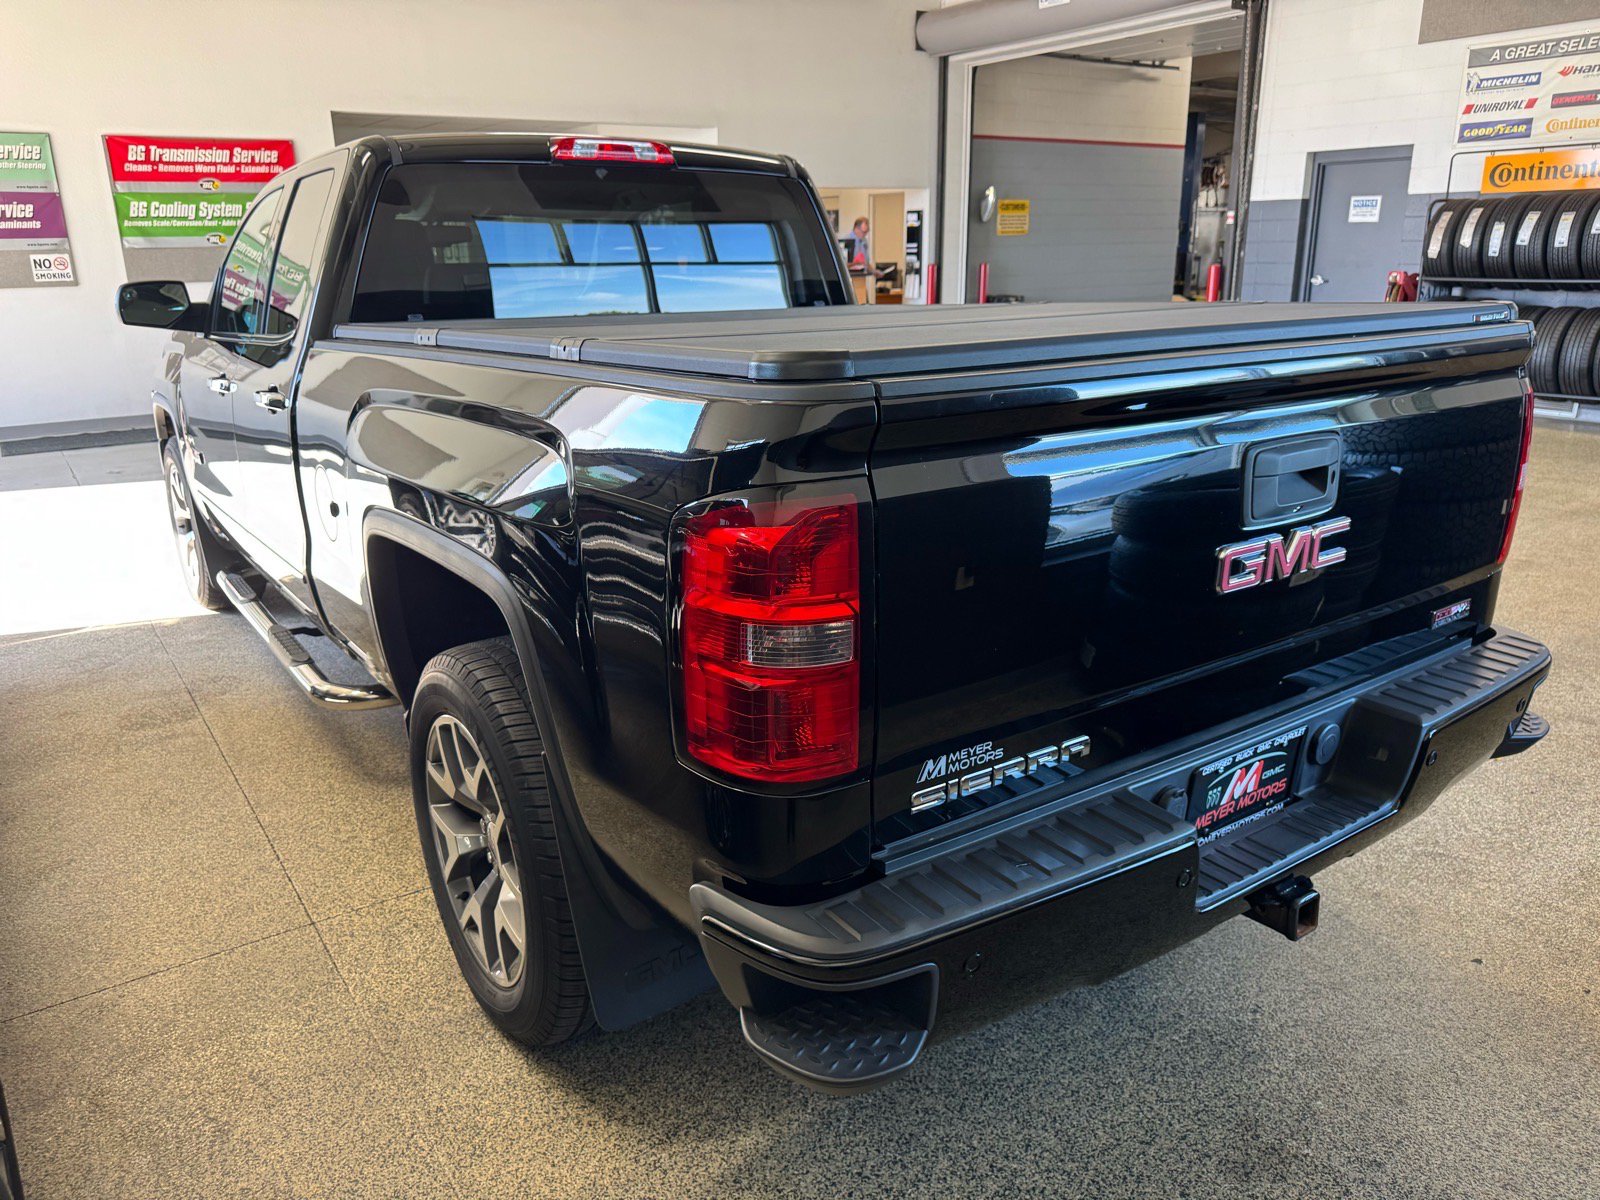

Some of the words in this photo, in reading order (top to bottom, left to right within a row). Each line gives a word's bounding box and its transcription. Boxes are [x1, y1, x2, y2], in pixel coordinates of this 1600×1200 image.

[1489, 49, 1500, 62] A
[1504, 41, 1557, 60] GREAT
[1558, 35, 1600, 53] SELE
[1479, 74, 1539, 88] MICHELIN
[1473, 99, 1524, 113] UNIROYAL
[1463, 123, 1527, 138] GOODYEAR
[127, 144, 146, 161] BG
[149, 145, 230, 163] Transmission
[232, 147, 279, 164] Service
[17, 162, 47, 170] Steering
[124, 162, 153, 172] Cleans
[158, 163, 194, 173] Removes
[195, 164, 216, 173] Worn
[217, 164, 236, 173] Fluid
[240, 165, 270, 174] Extends
[270, 165, 284, 174] Life
[129, 201, 148, 218] BG
[150, 201, 197, 220] Cooling
[198, 201, 243, 220] System
[0, 220, 41, 229] aminants
[33, 258, 52, 269] NO
[35, 272, 72, 280] SMOKING
[1215, 515, 1351, 594] GMC
[948, 741, 993, 763] MEYER
[947, 748, 1004, 774] MOTORS
[911, 735, 1091, 815] SIERRA
[1261, 763, 1286, 780] GMC
[1195, 800, 1236, 829] MEYER
[1236, 777, 1287, 811] MOTORS
